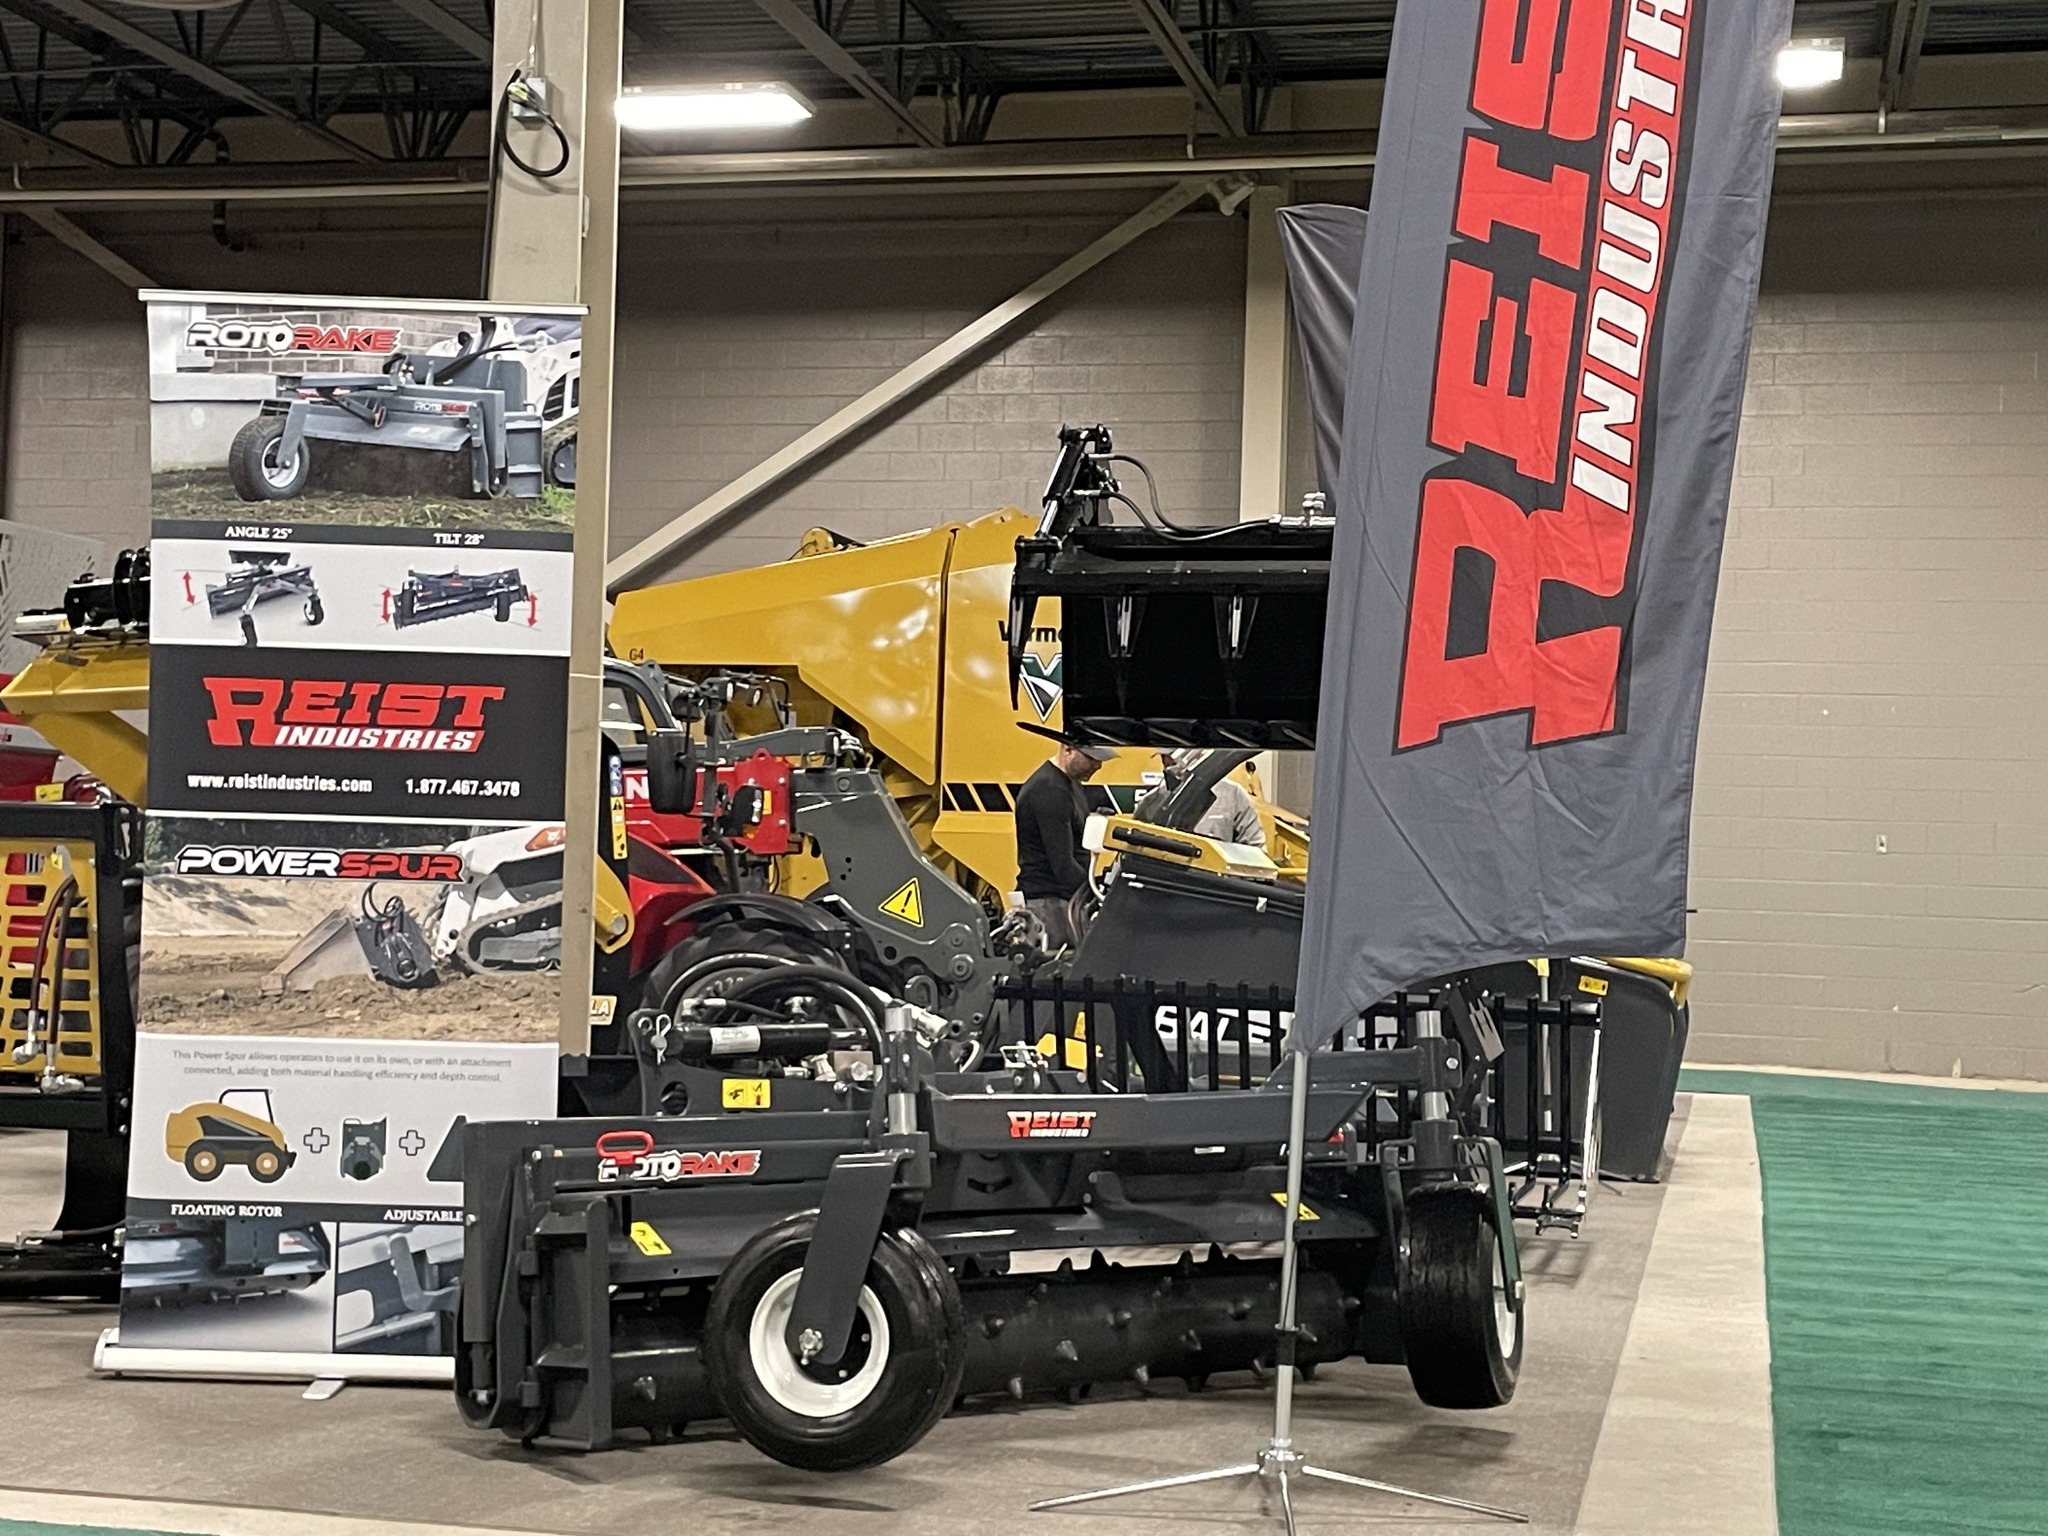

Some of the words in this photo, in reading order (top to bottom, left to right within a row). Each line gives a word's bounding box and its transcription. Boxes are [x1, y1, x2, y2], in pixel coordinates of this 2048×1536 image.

[225, 525, 270, 539] ANGLE
[433, 532, 463, 545] TILT
[629, 648, 645, 661] G4
[203, 677, 505, 746] REIST
[274, 725, 482, 751] INDUSTRIES
[186, 773, 373, 793] www.reistindustries.com
[405, 778, 521, 798] 1.877.467.3478
[172, 1050, 191, 1059] This
[194, 1051, 222, 1060] Power
[225, 1051, 246, 1062] Spur
[249, 1051, 278, 1061] allows
[279, 1053, 323, 1063] operators
[325, 1053, 335, 1062] to
[336, 1056, 351, 1064] use
[354, 1055, 361, 1064] it
[363, 1056, 375, 1064] on
[425, 1056, 445, 1066] with
[447, 1058, 458, 1066] an
[460, 1057, 512, 1068] attachment
[183, 1066, 235, 1076] connected,
[237, 1066, 269, 1077] adding
[271, 1066, 292, 1076] both
[294, 1066, 331, 1077] material
[333, 1069, 373, 1080] handling
[375, 1069, 418, 1081] efficiency
[420, 1070, 437, 1080] and
[439, 1070, 466, 1082] depth
[1006, 1110, 1097, 1138] REIST
[171, 1203, 236, 1217] FLOATING
[239, 1204, 283, 1217] ROTOR
[383, 1209, 463, 1222] ADJUSTABLE
